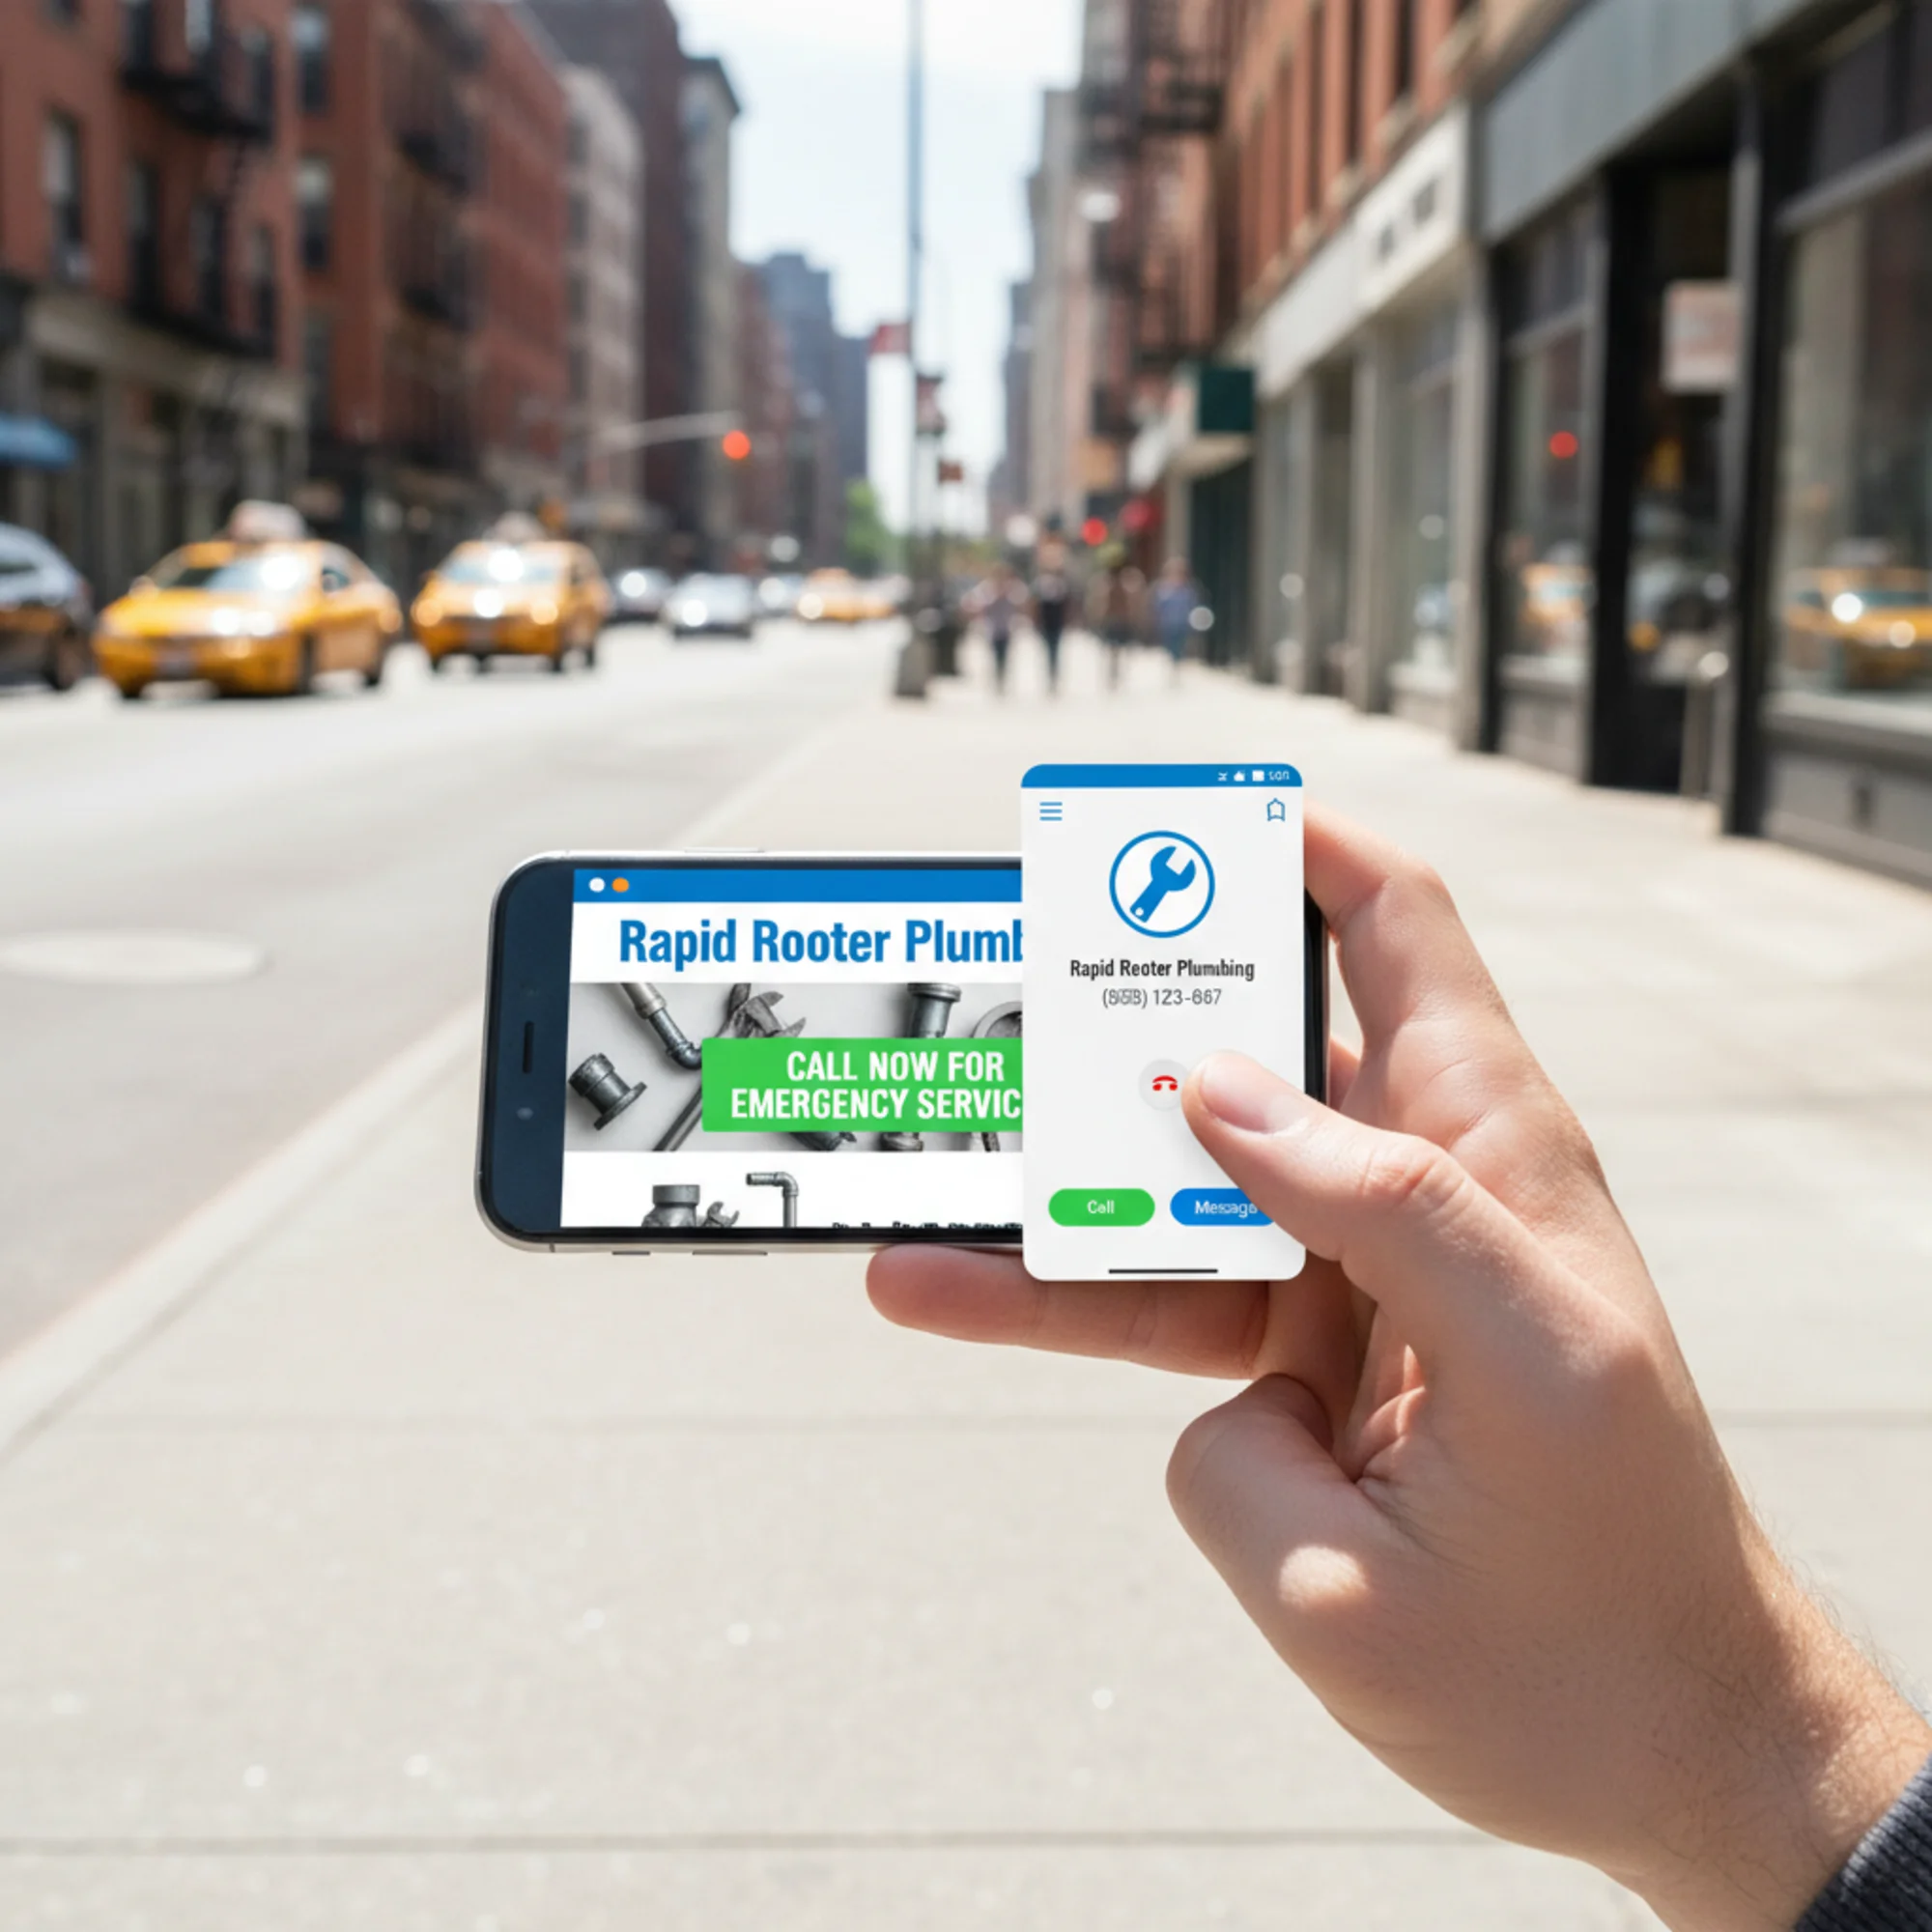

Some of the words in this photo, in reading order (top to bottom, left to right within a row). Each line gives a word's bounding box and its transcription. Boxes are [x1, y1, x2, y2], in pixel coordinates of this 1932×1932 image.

[619, 919, 737, 972] Rapid
[753, 920, 892, 963] Rooter
[1069, 957, 1115, 981] Rapid
[786, 1050, 858, 1082] CALL
[868, 1050, 939, 1082] NOW
[948, 1050, 1005, 1082] FOR
[731, 1088, 909, 1120] EMERGENCY
[917, 1088, 1022, 1120] SERVIC
[1086, 1200, 1115, 1215] Call
